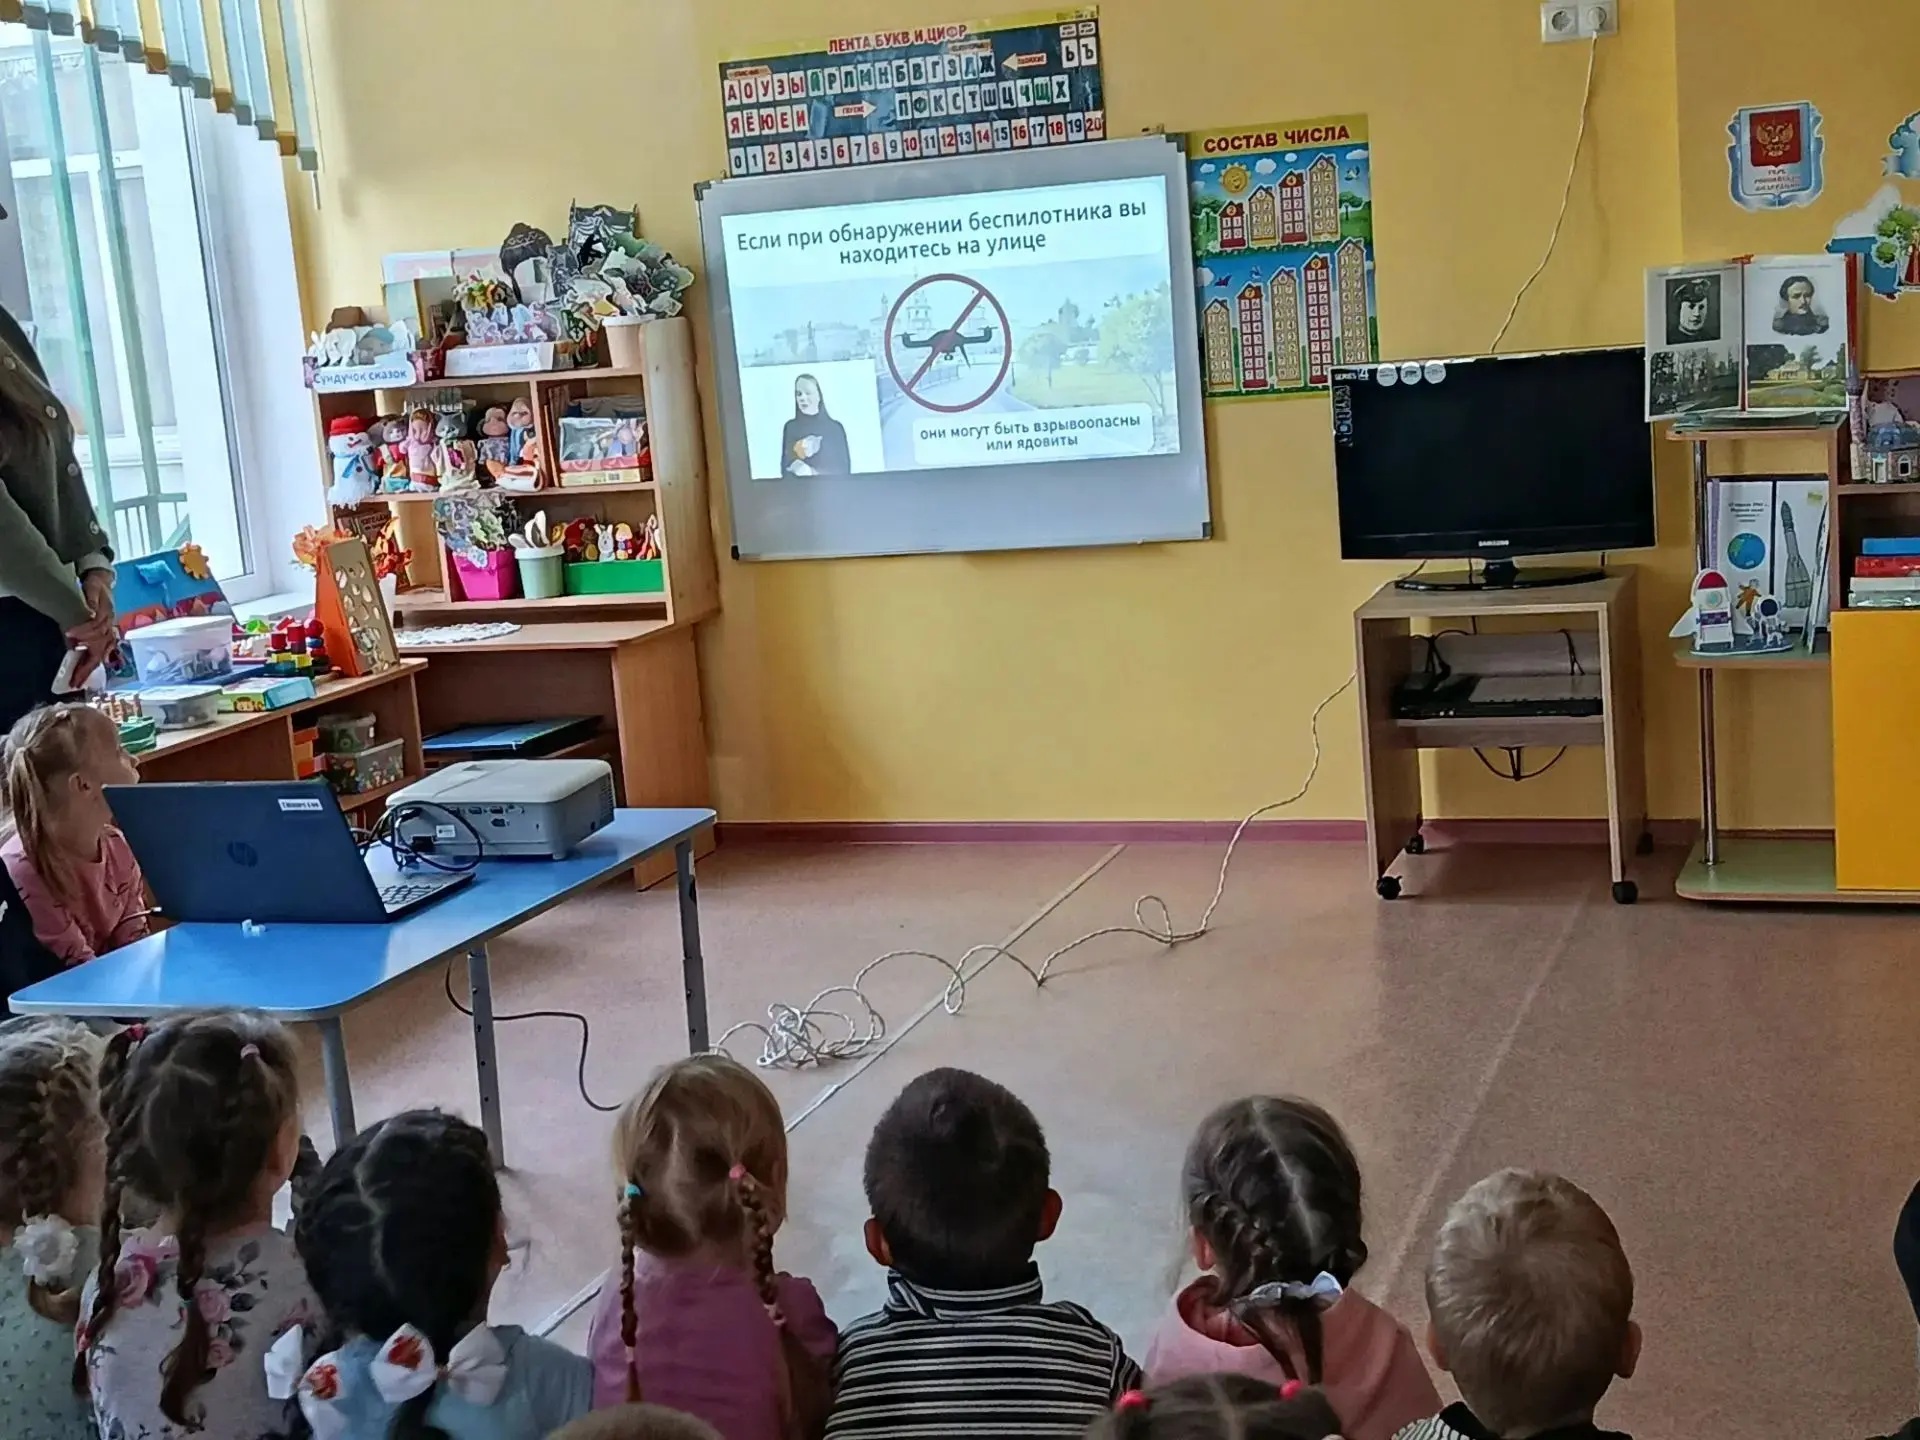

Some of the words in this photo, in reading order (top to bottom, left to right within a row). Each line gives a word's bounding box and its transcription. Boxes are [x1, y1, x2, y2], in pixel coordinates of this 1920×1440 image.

[828, 36, 872, 53] ЛЕНТА
[875, 30, 910, 48] БУКВ
[914, 30, 923, 43] И
[927, 25, 968, 43] ЦИФР
[728, 84, 737, 100] А
[791, 76, 804, 94] Ы
[828, 72, 837, 90] Р
[895, 64, 906, 82] Б
[912, 62, 922, 80] В
[931, 61, 939, 79] Г
[979, 55, 994, 74] Ж
[898, 98, 909, 117] П
[914, 96, 927, 114] Ф
[969, 91, 977, 108] Т
[983, 88, 996, 107] Ш
[1020, 84, 1031, 102] Ч
[730, 117, 740, 134] Я
[760, 114, 774, 130] Ю
[780, 112, 789, 128] Е
[752, 154, 758, 167] 1
[768, 152, 776, 165] 2
[786, 150, 793, 163] 3
[803, 148, 810, 161] 4
[820, 146, 828, 160] 5
[837, 145, 844, 159] 6
[854, 143, 862, 156] 7
[872, 141, 880, 155] 8
[890, 139, 898, 153] 9
[904, 137, 918, 151] 10
[925, 135, 936, 149] 11
[941, 133, 955, 148] 12
[958, 132, 972, 145] 13
[977, 129, 990, 144] 14
[995, 127, 1008, 141] 15
[1013, 125, 1026, 140] 16
[1031, 122, 1044, 137] 17
[1049, 122, 1063, 136] 18
[1068, 119, 1082, 133] 19
[1087, 118, 1102, 132] 20
[1203, 130, 1278, 153] СОСТАВ
[1284, 125, 1350, 144] ЧИСЛА
[737, 232, 782, 251] Если
[787, 230, 823, 250] при
[829, 217, 962, 244] обнаружении
[970, 202, 1112, 232] беспилотника
[1119, 201, 1146, 217] вы
[840, 240, 951, 266] находитесь
[957, 239, 980, 253] на
[987, 232, 1047, 256] улице
[313, 373, 366, 384] Сундучок
[369, 370, 407, 380] сказок
[920, 427, 946, 440] они
[950, 424, 990, 441] могут
[994, 419, 1030, 436] быть
[1033, 414, 1141, 436] взрывоопасны
[987, 438, 1013, 451] или
[1016, 434, 1078, 451] ядовиты
